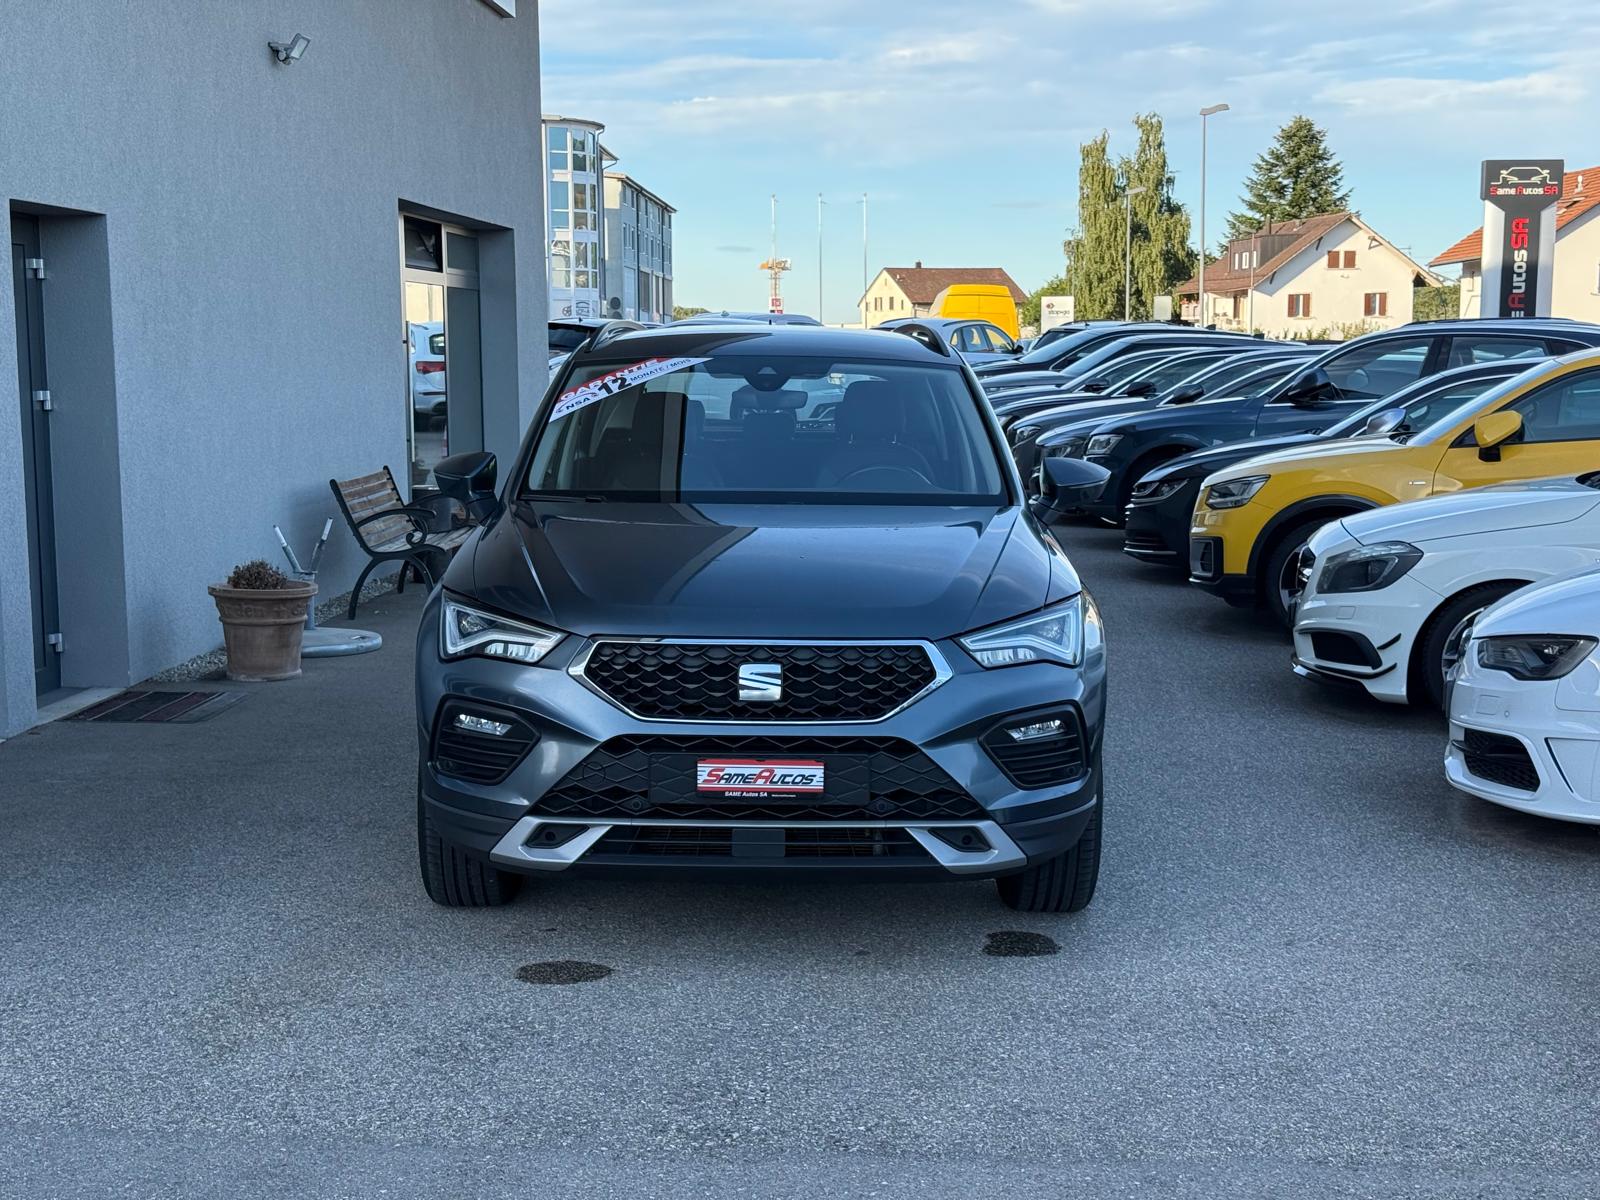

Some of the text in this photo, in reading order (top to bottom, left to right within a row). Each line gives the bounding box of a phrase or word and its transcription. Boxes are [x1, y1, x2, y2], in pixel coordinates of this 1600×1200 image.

[566, 397, 590, 410] NSA
[598, 377, 632, 395] 12
[630, 366, 665, 381] MONATE
[671, 358, 692, 369] MOIS
